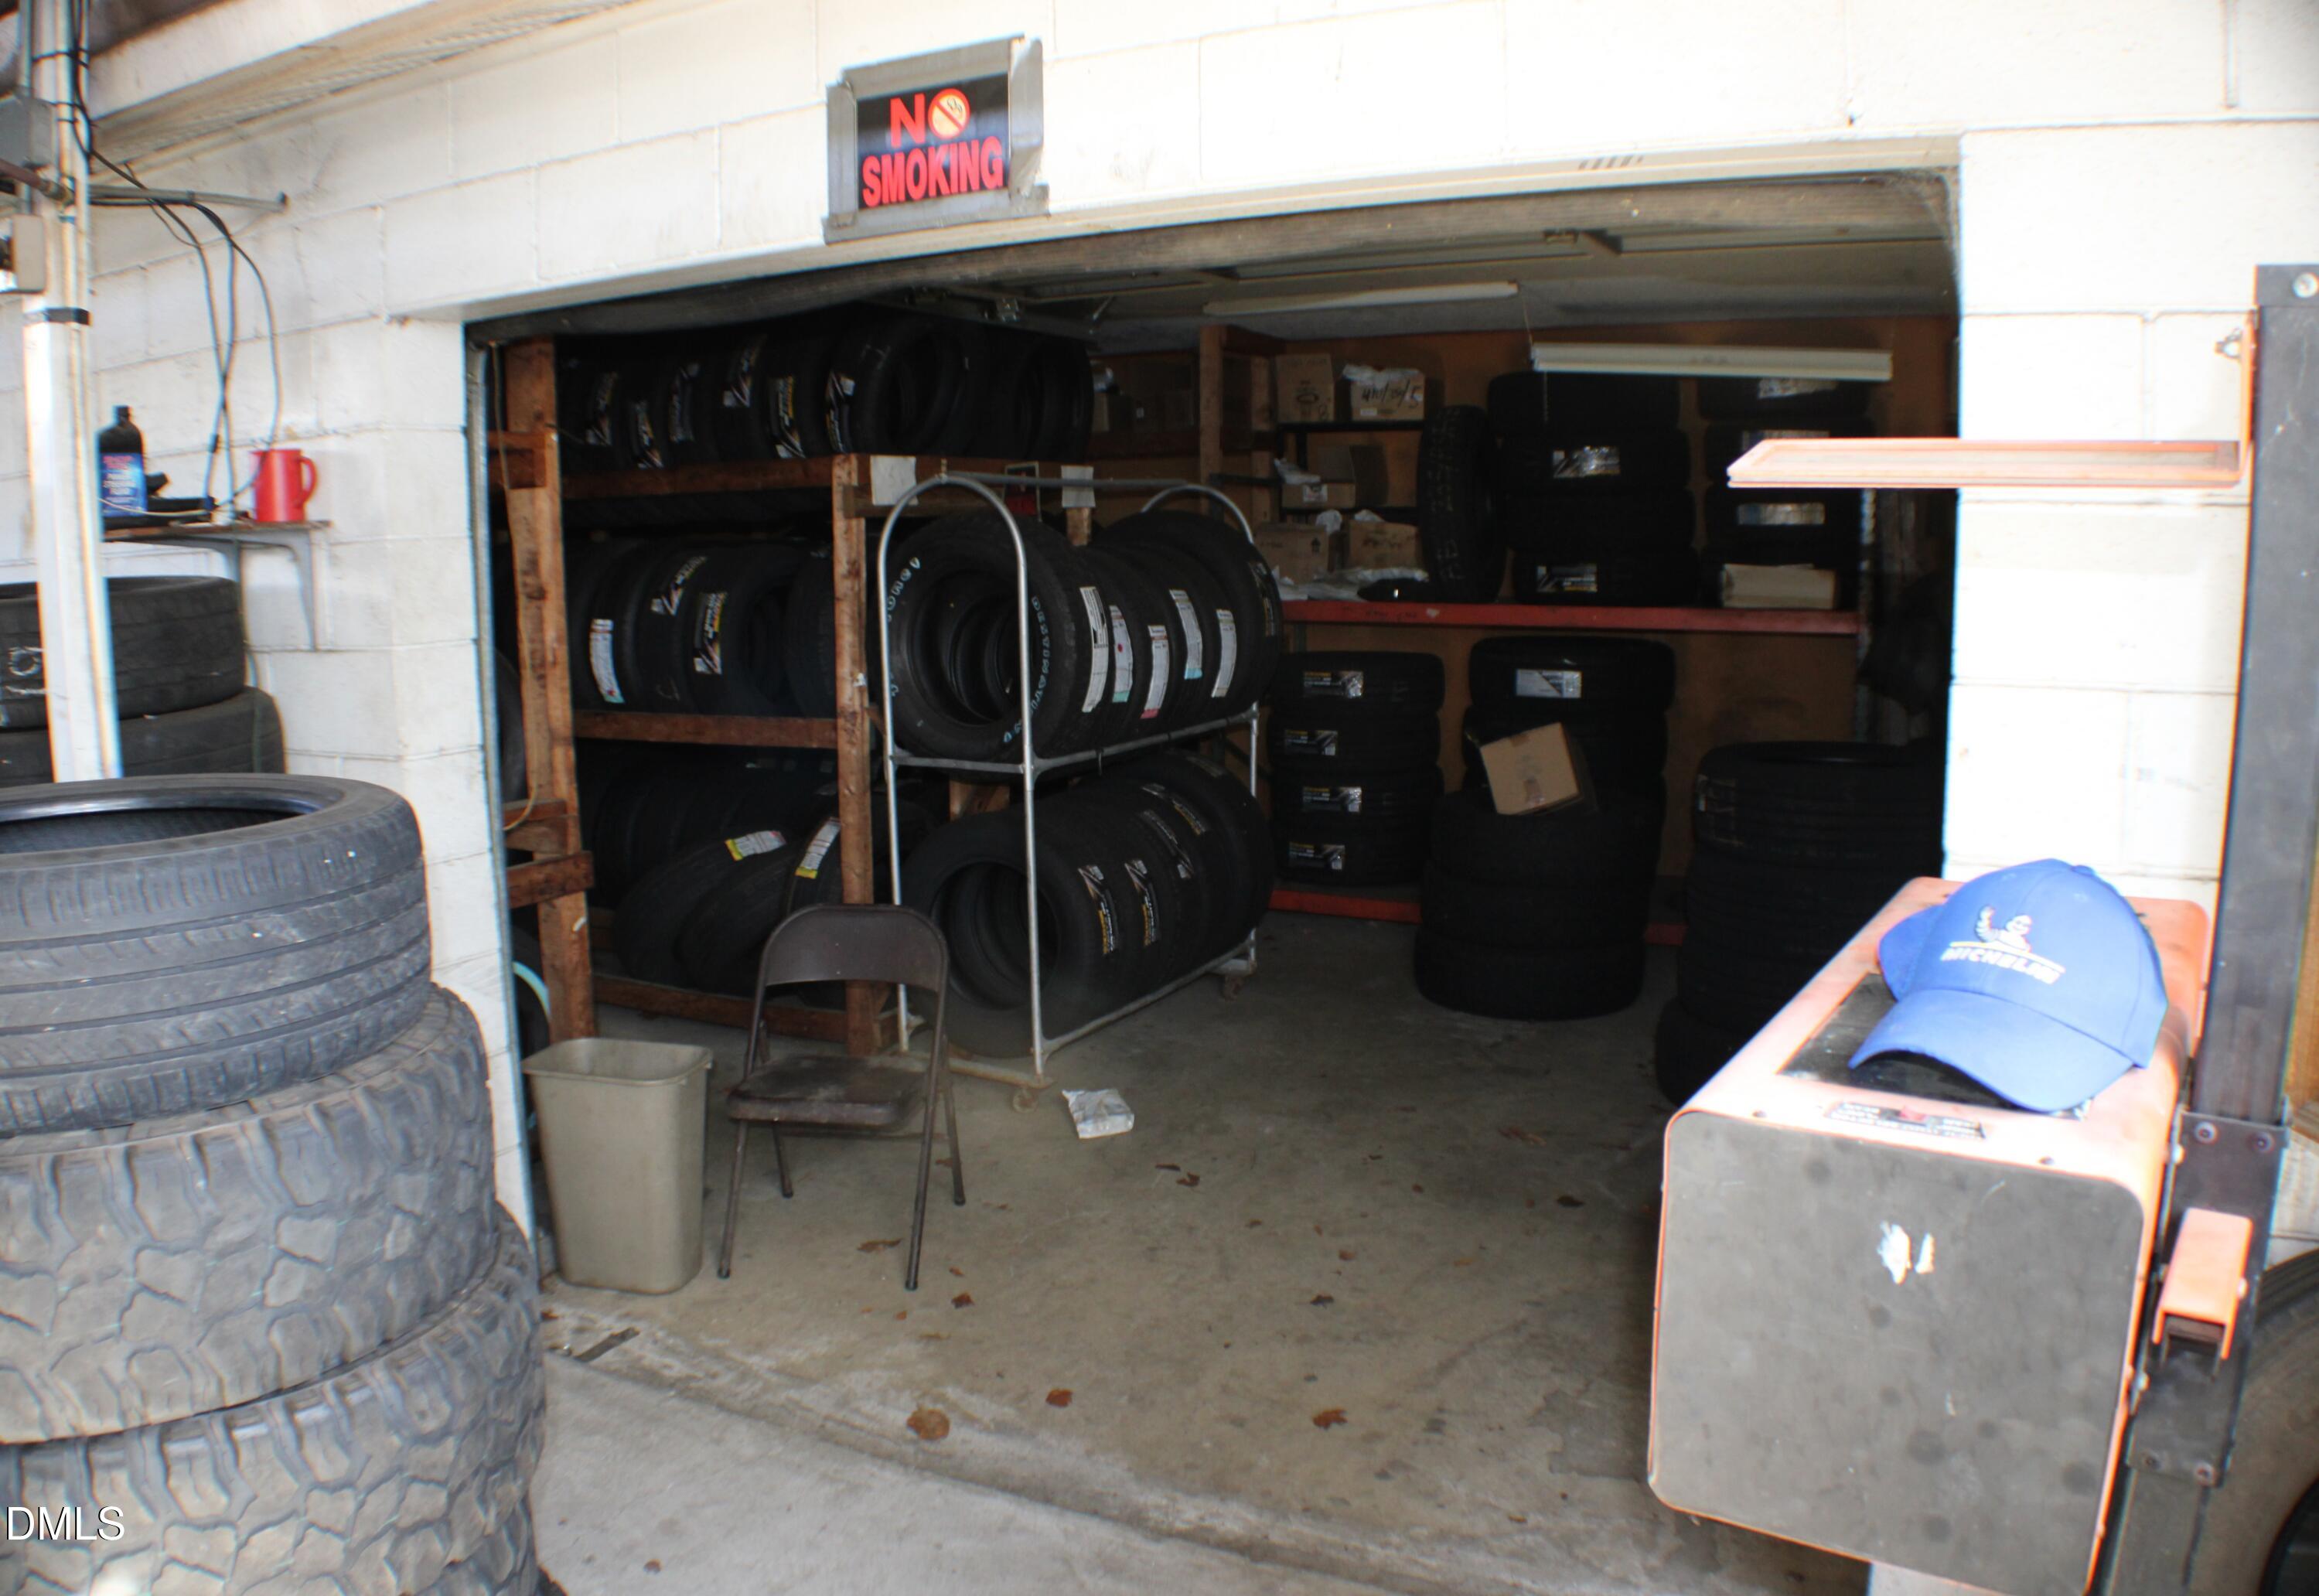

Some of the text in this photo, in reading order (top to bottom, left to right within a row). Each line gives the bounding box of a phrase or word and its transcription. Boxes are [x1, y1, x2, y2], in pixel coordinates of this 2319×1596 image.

[890, 88, 970, 148] NO
[862, 136, 1004, 207] SMOKING
[1941, 947, 2060, 984] MICHELIN
